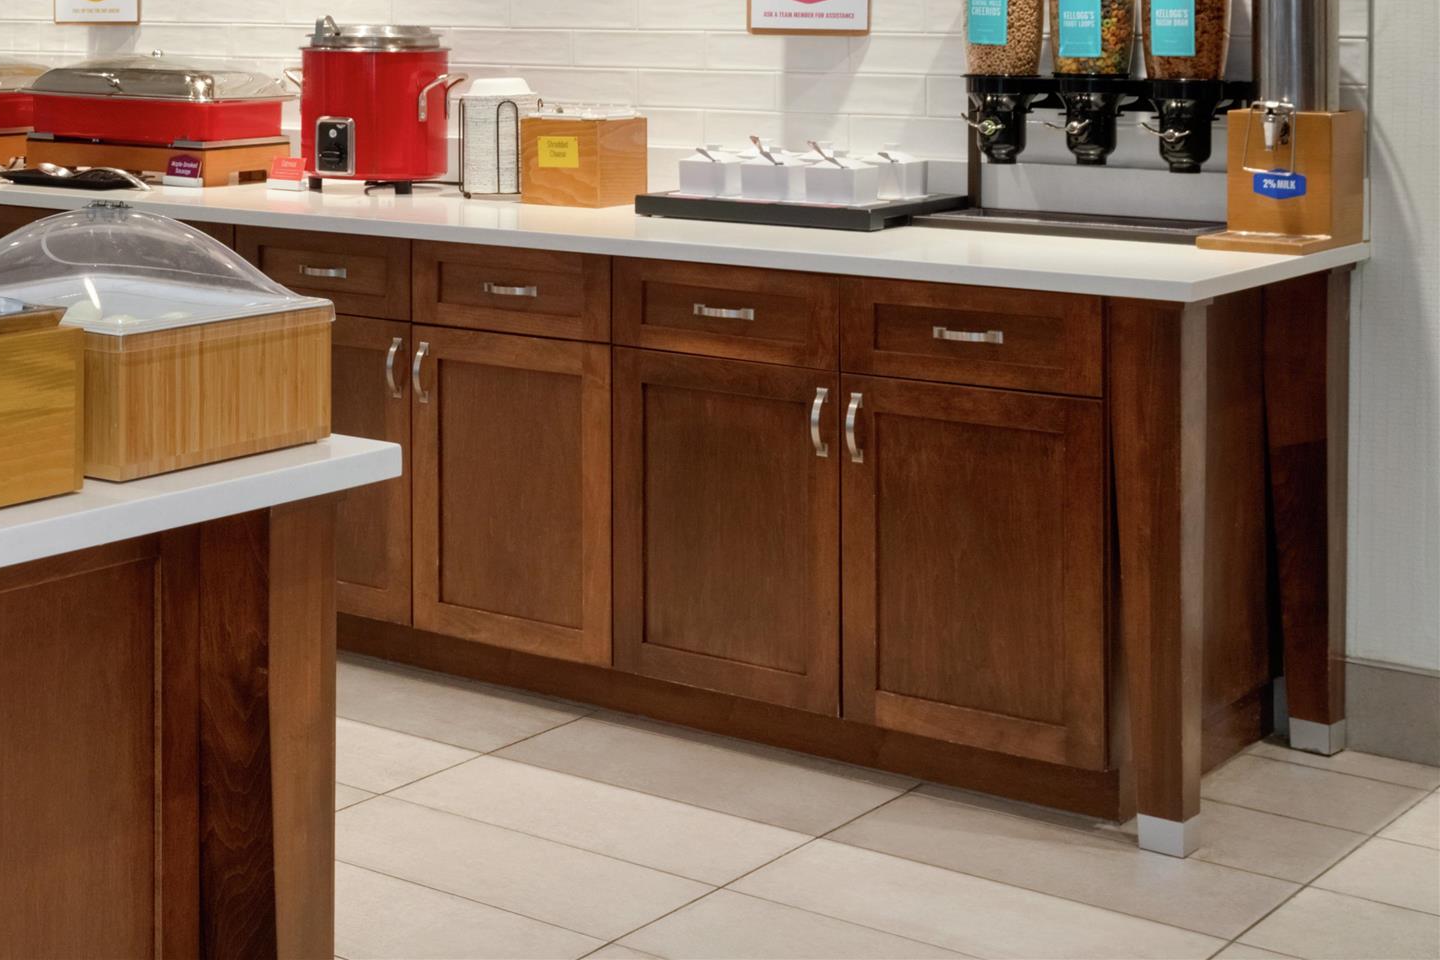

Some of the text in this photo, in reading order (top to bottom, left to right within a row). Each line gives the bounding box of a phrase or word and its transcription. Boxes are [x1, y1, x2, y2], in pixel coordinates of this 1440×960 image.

[971, 7, 1001, 16] CHEERIOS
[1263, 178, 1296, 189] 2% MILK
